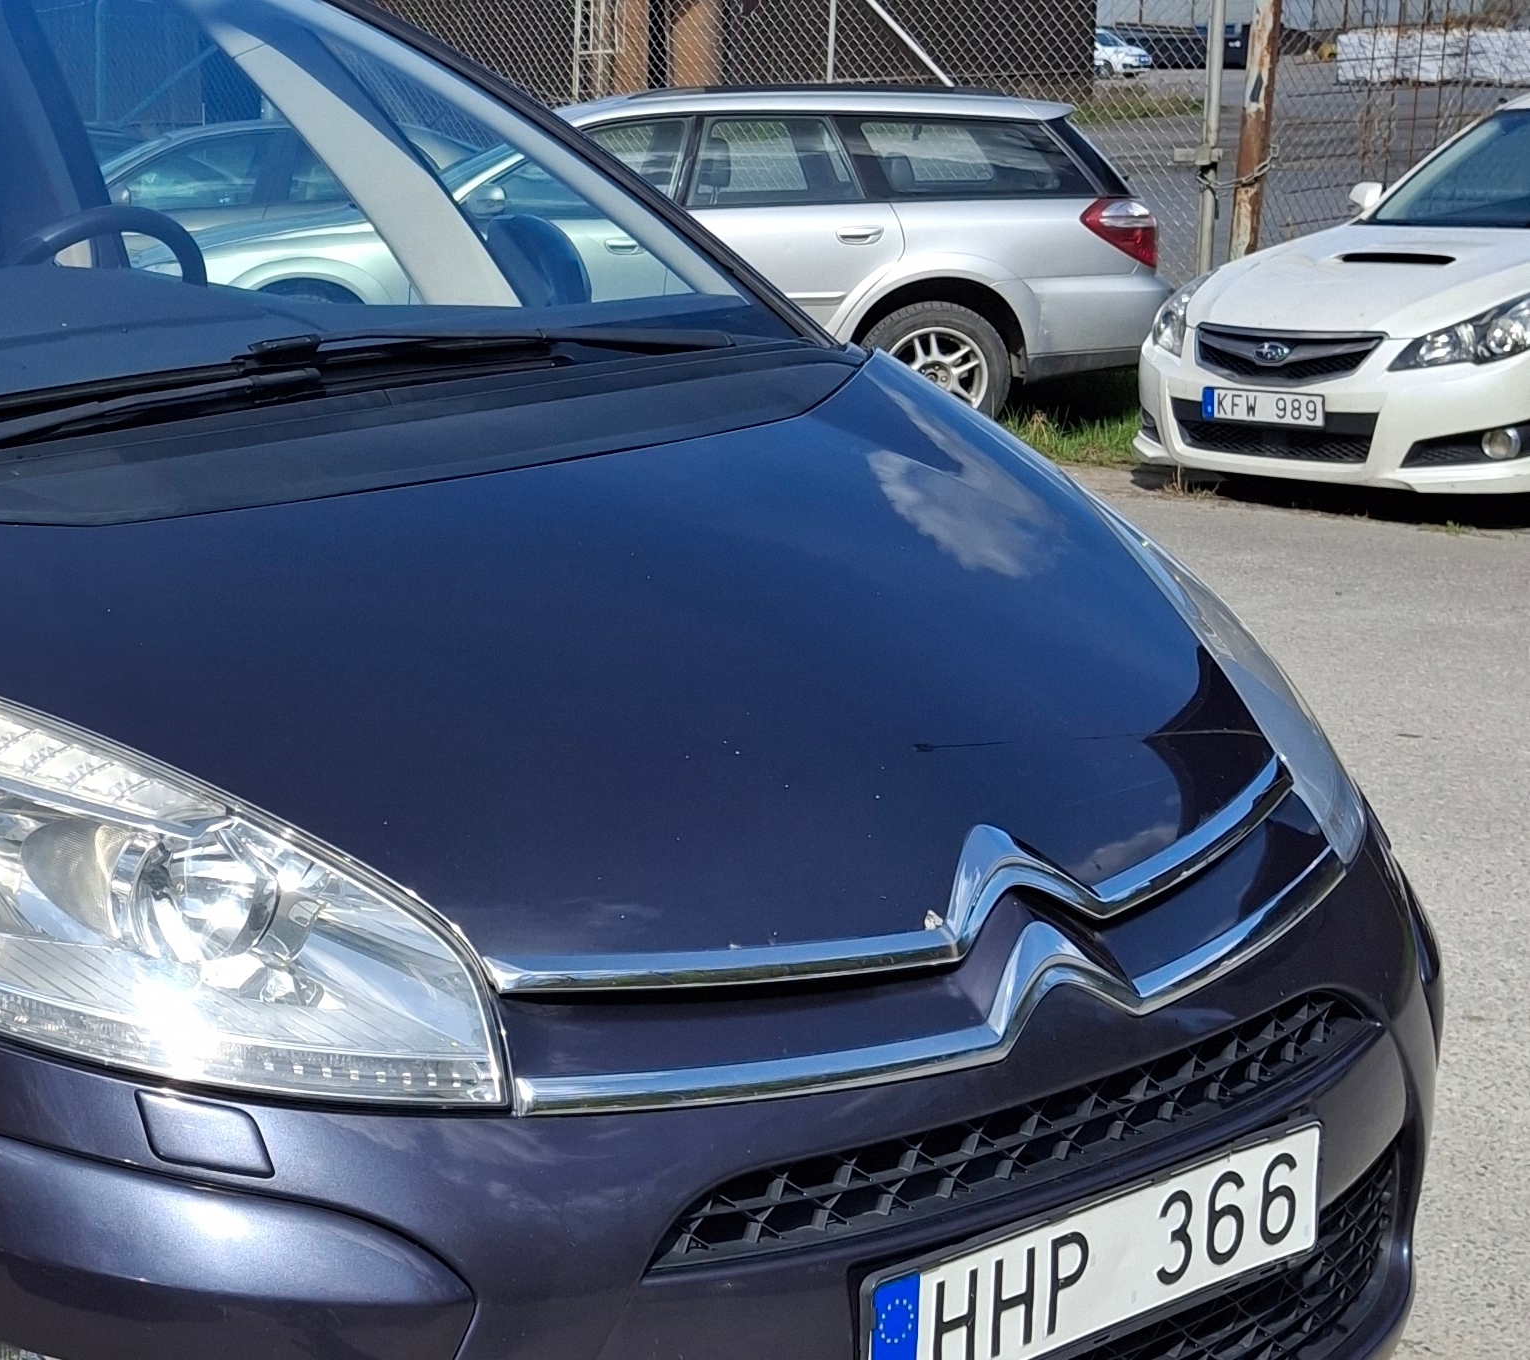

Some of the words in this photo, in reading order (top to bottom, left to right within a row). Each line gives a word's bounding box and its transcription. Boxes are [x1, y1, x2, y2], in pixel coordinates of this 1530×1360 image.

[1217, 392, 1257, 417] KFW
[1275, 397, 1317, 422] 989
[1156, 1153, 1297, 1285] 366
